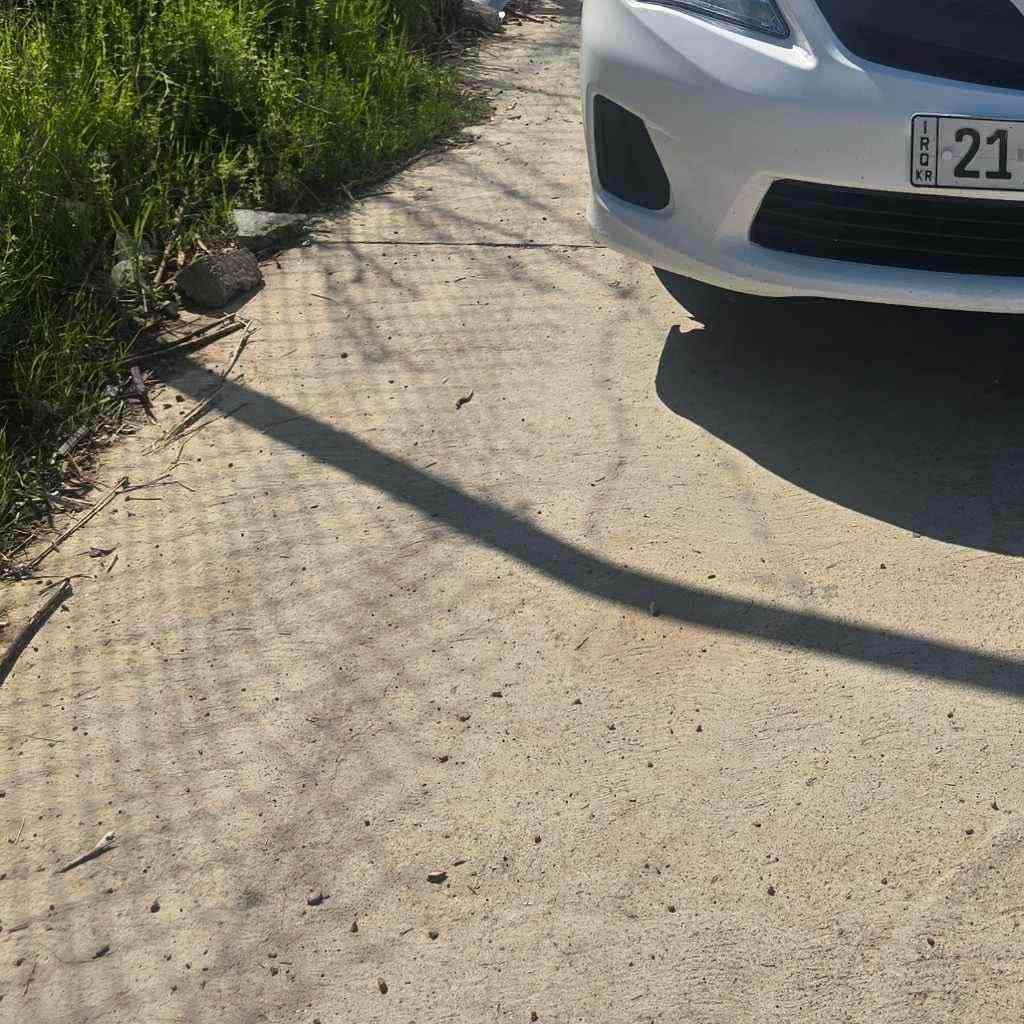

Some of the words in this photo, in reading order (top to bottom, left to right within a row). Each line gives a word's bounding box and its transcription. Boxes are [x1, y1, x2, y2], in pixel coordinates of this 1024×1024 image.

[919, 120, 931, 167] IRQ
[953, 127, 1012, 180] 21
[914, 169, 933, 183] KR
